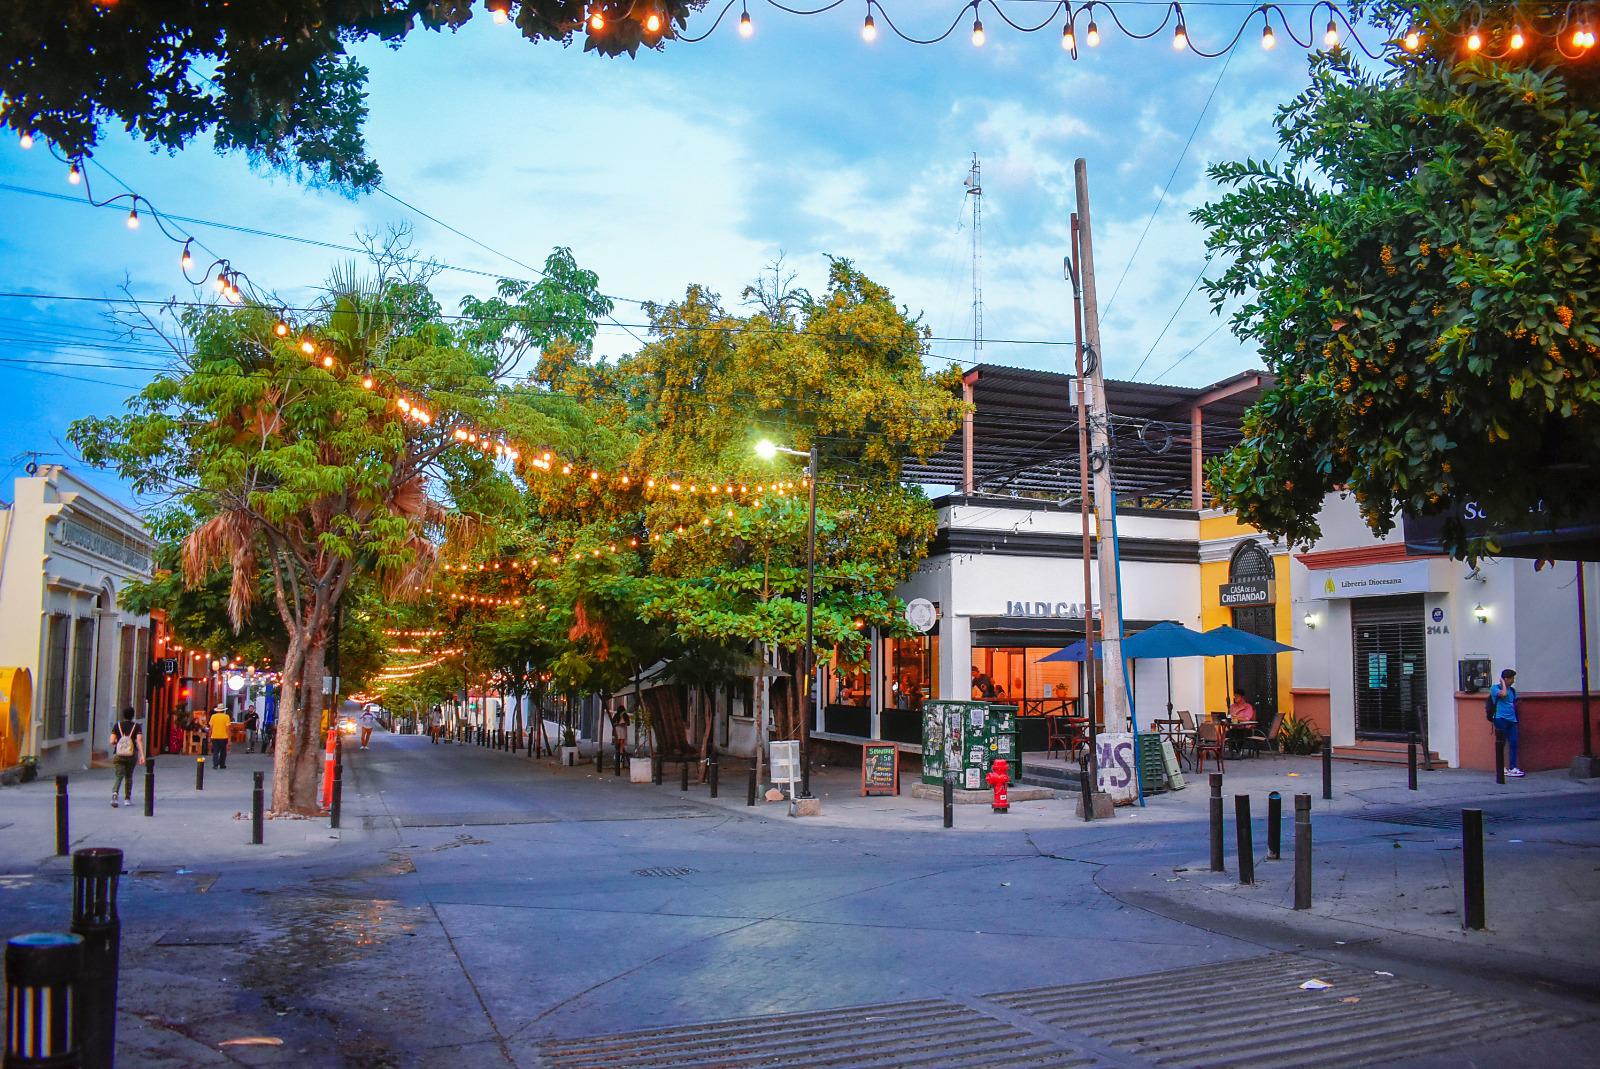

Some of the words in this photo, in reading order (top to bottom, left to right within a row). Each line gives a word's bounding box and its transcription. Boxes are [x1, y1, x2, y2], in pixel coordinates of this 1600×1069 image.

[1368, 578, 1402, 586] Diocesana
[1230, 585, 1245, 594] CASA
[1221, 590, 1267, 603] CRISTIANDAD
[1442, 625, 1450, 635] A
